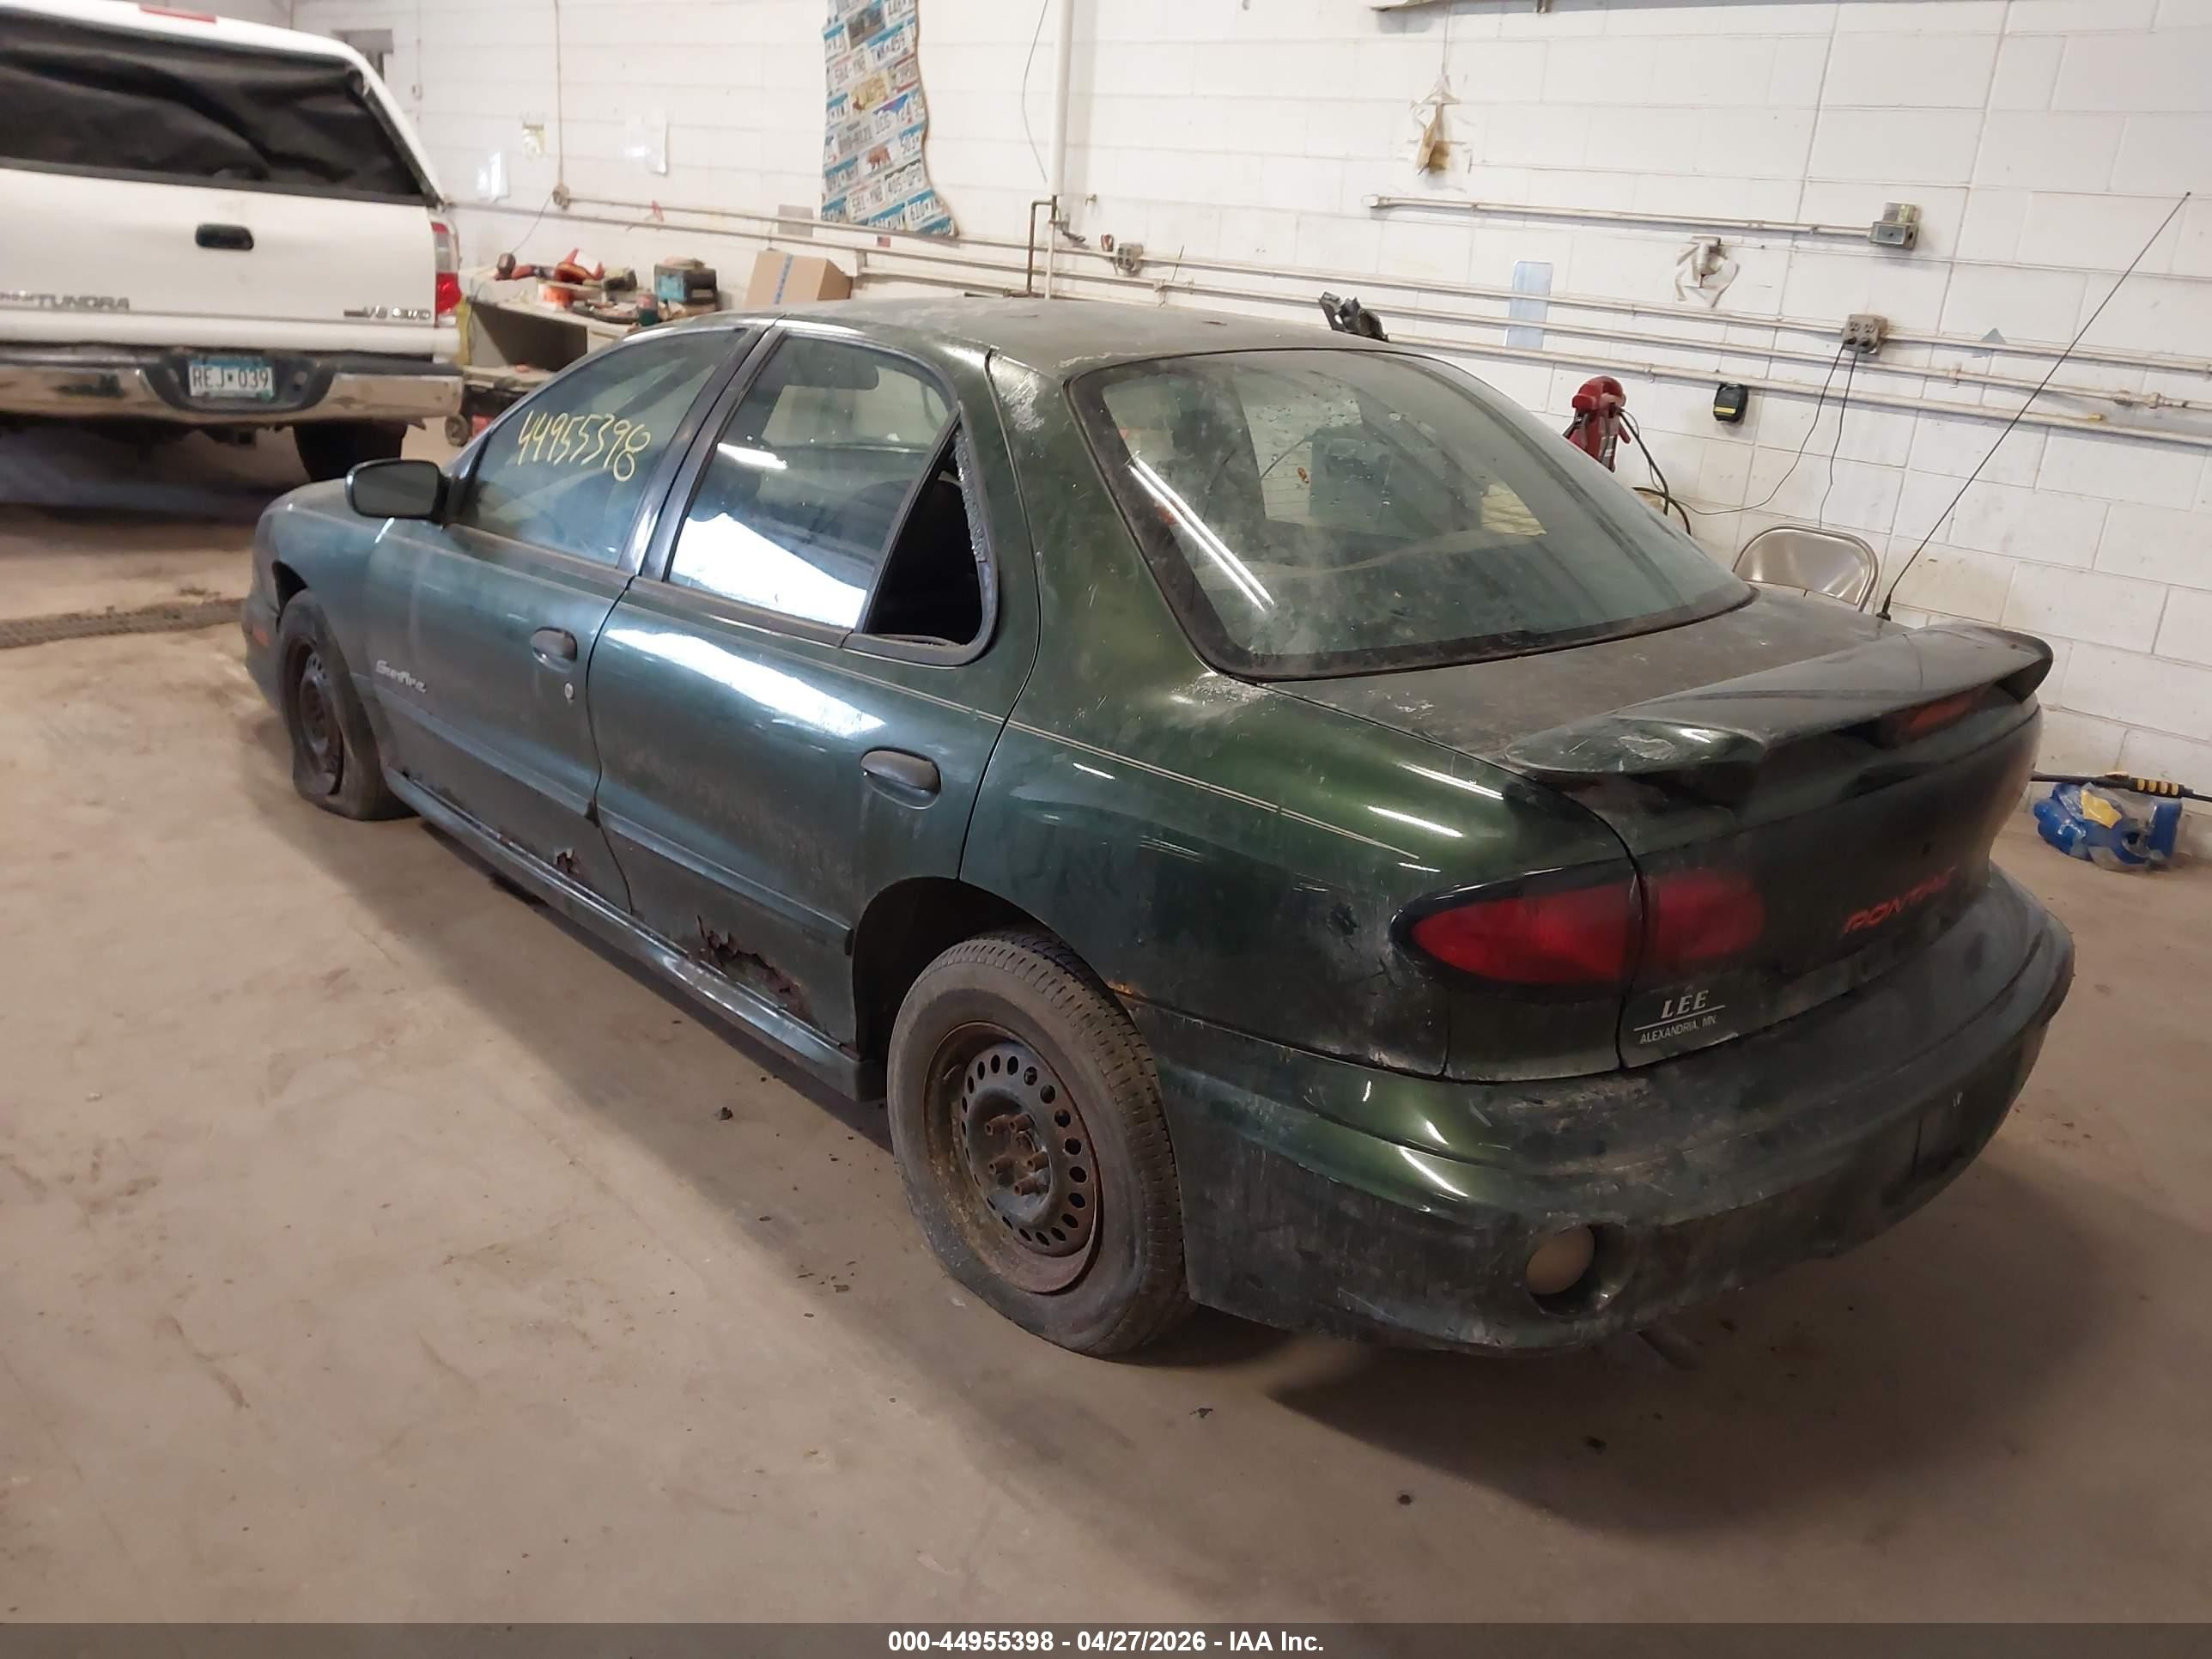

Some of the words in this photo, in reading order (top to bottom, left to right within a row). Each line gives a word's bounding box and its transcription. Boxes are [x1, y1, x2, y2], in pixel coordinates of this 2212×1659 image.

[34, 294, 130, 312] TUNDRA
[518, 410, 652, 482] 44955398
[1661, 990, 1709, 1019] LEE
[1640, 1019, 1699, 1044] ALEXANDRIA,
